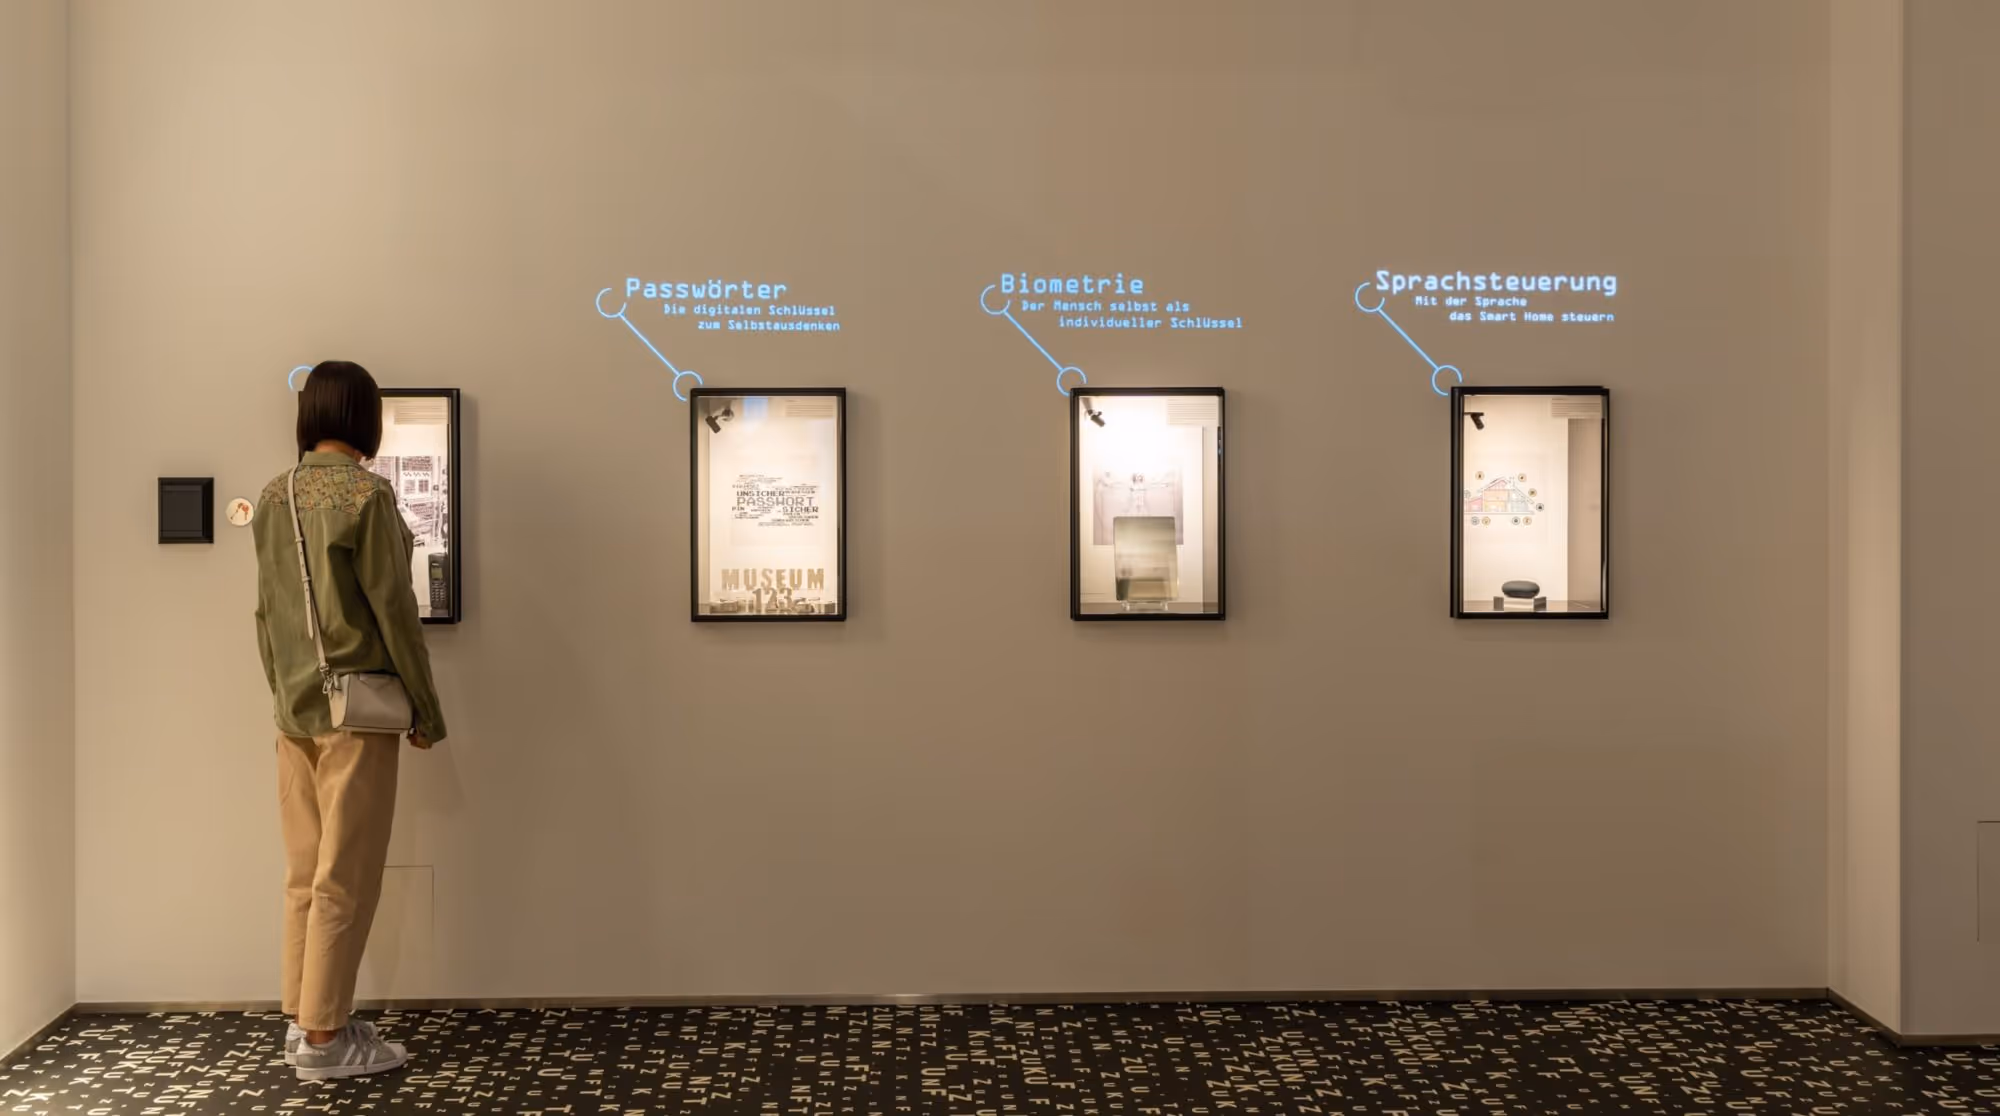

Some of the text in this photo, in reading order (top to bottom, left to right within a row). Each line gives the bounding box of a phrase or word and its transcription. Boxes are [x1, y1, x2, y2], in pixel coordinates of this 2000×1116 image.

[626, 277, 788, 300] Passwörter
[1000, 272, 1144, 294] Biometrie
[1376, 270, 1617, 296] Sprachsteuerung
[1020, 300, 1190, 313] Der Mensch selbst als
[1415, 295, 1528, 308] Mit der Sprache
[663, 303, 836, 317] Die digitalen Schlüssel
[1449, 311, 1615, 322] das Smart Home steuern
[697, 319, 841, 331] zum Selbstausdenken
[1059, 316, 1243, 329] individueller Schlüssel
[721, 568, 824, 590] MUSEUM
[752, 587, 793, 613] 123
